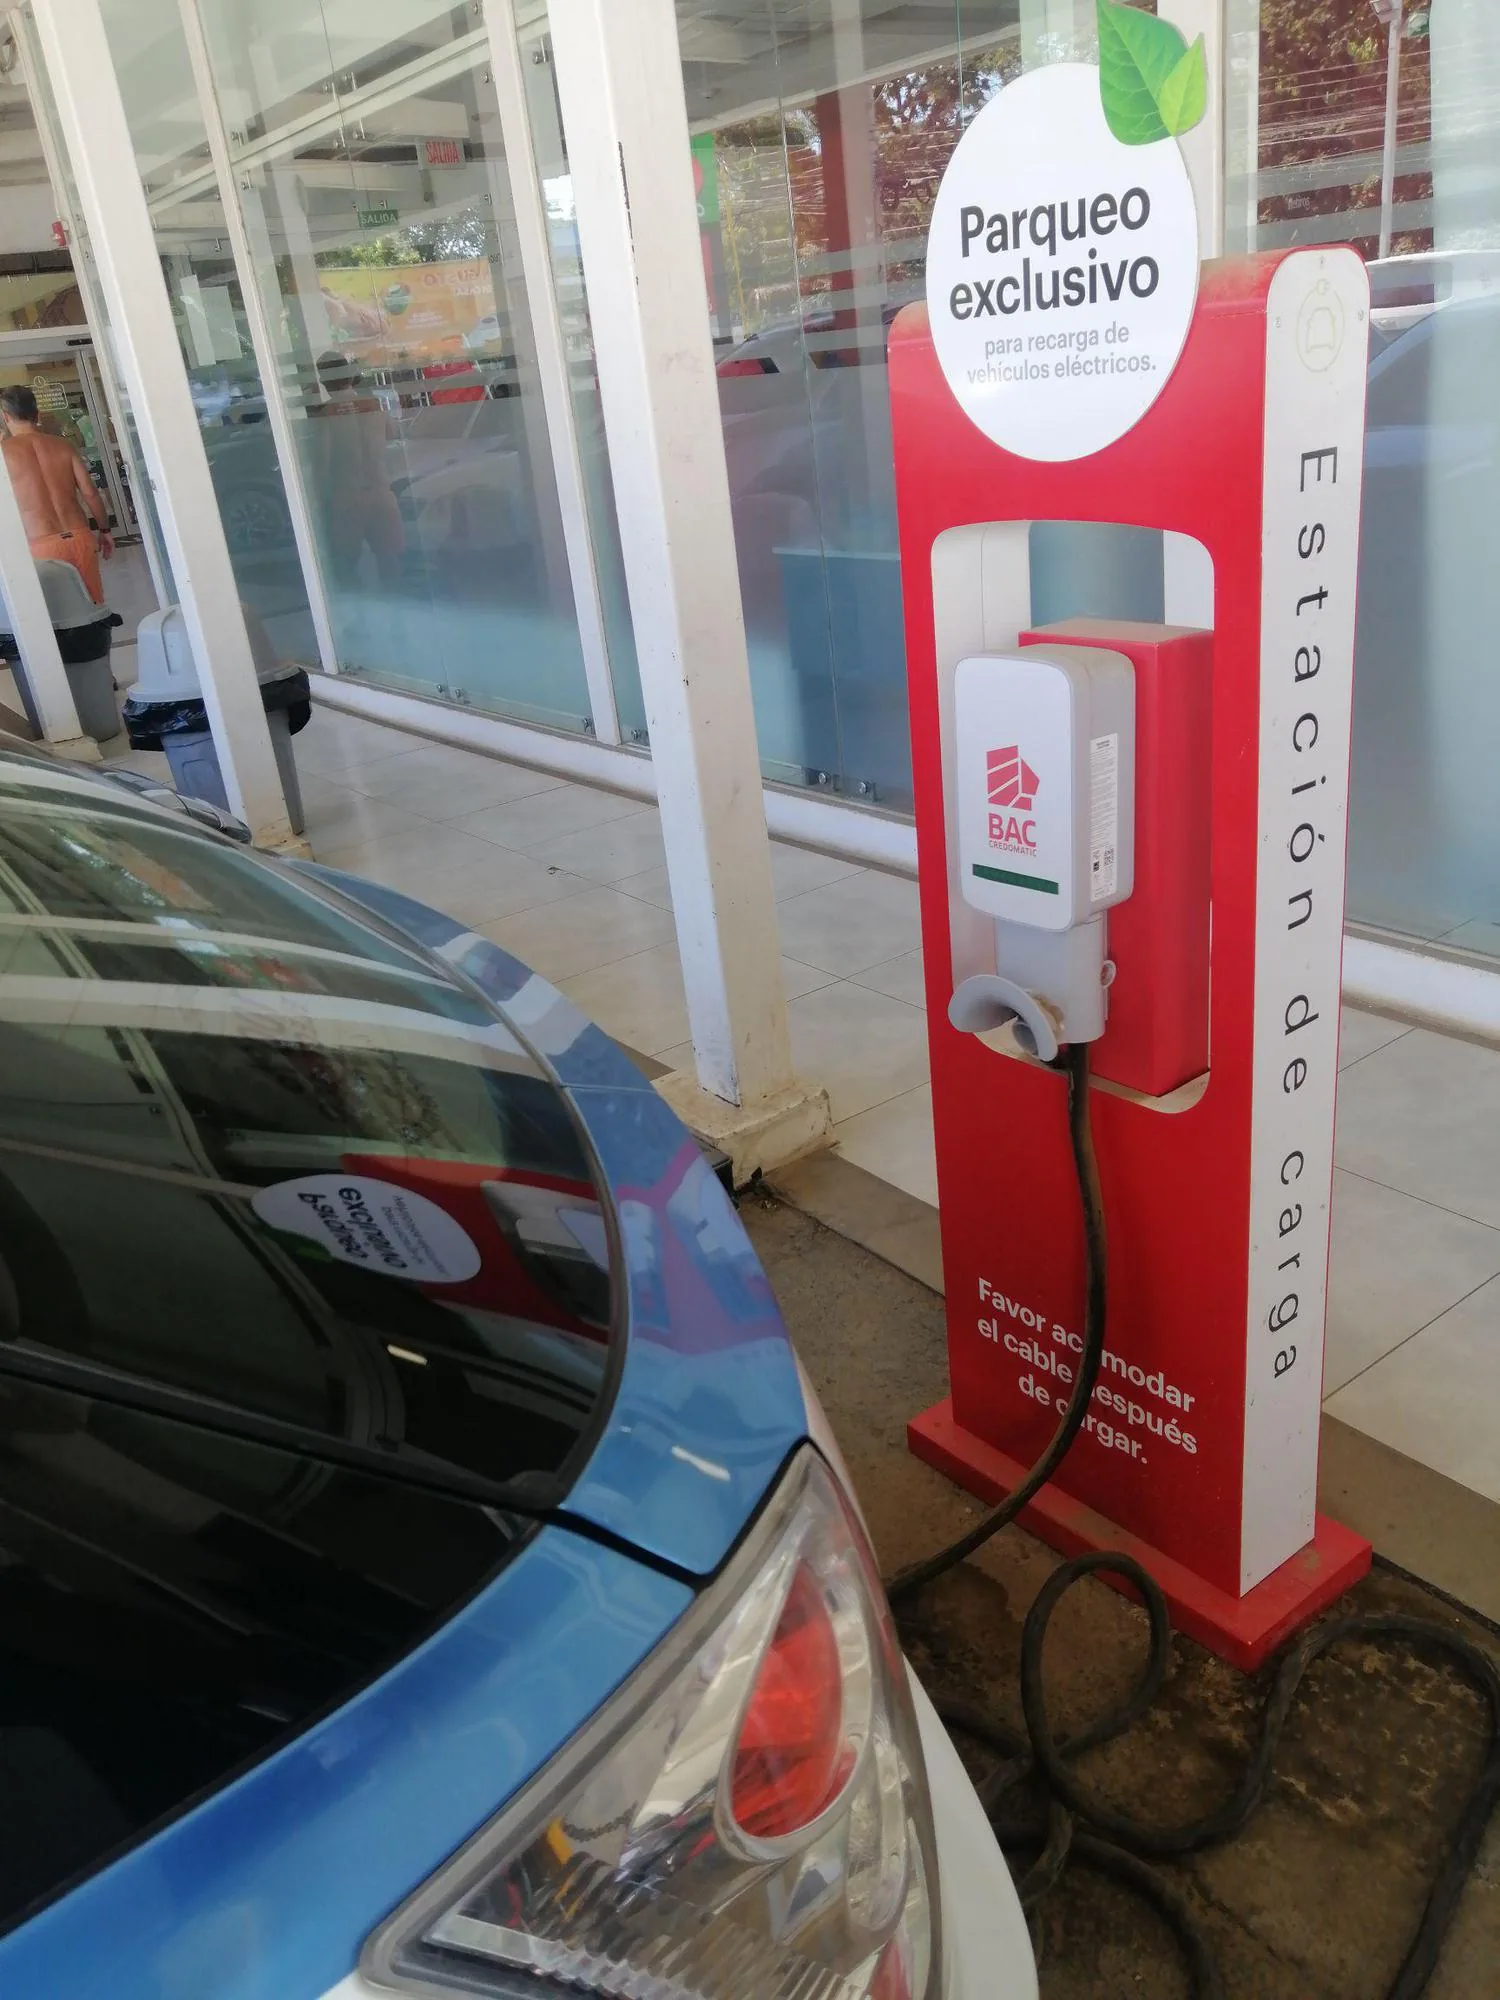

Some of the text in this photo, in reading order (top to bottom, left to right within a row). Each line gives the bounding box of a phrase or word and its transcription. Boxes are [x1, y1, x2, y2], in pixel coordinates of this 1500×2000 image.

[425, 141, 460, 164] SALIDA
[361, 212, 397, 225] SALIDA
[960, 186, 1151, 258] Parqueo
[949, 247, 1160, 320] exclusivo
[985, 321, 1130, 359] para recarga de
[967, 352, 1157, 384] vehículos eléctricos.
[988, 812, 1037, 848] BAC
[989, 839, 1037, 858] CREDOMATIC
[1268, 446, 1338, 1379] Estación de carga
[978, 1277, 1196, 1413] Favor acmodar
[977, 1318, 1198, 1454] el cable espués
[1018, 1373, 1050, 1407] de
